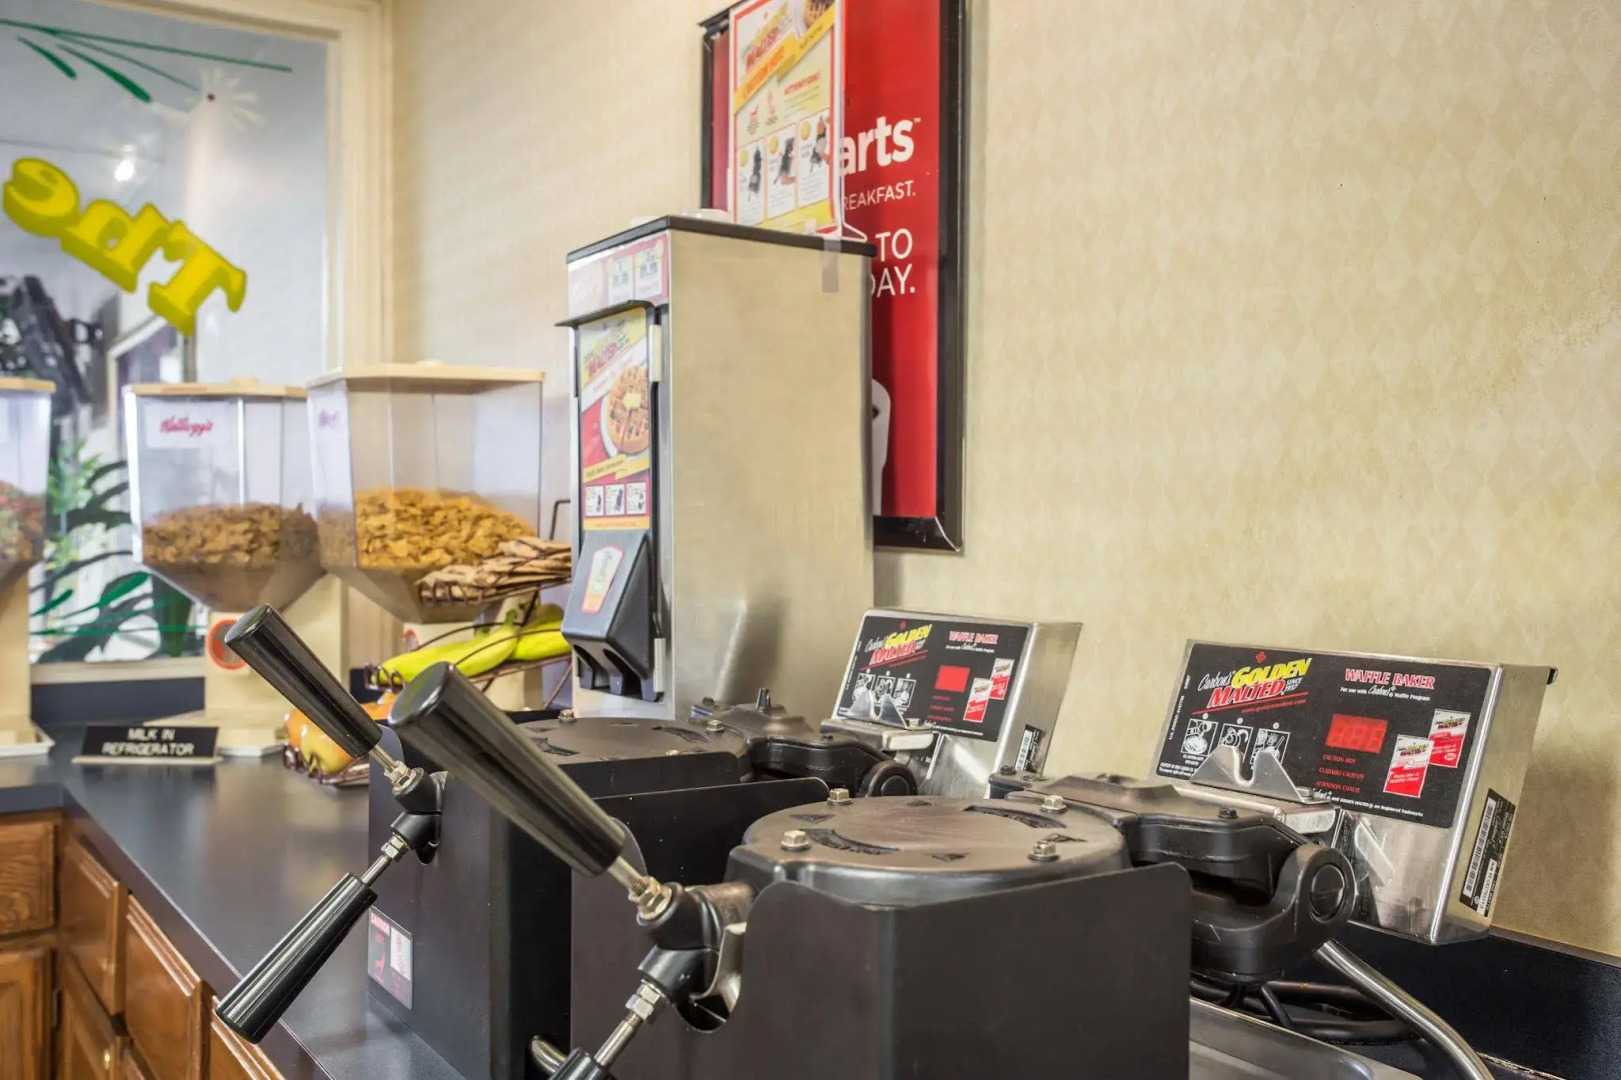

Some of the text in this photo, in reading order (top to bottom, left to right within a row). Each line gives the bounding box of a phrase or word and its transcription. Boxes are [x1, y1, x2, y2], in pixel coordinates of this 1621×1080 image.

[875, 228, 913, 262] TO
[885, 624, 933, 649] GOLDEN
[1231, 658, 1312, 688] GOLDEN
[1344, 668, 1436, 691] WAFFLE BAKER
[1207, 680, 1286, 709] MALTED
[127, 728, 175, 741] MILK IN
[102, 742, 195, 756] REFRIGERATOR
